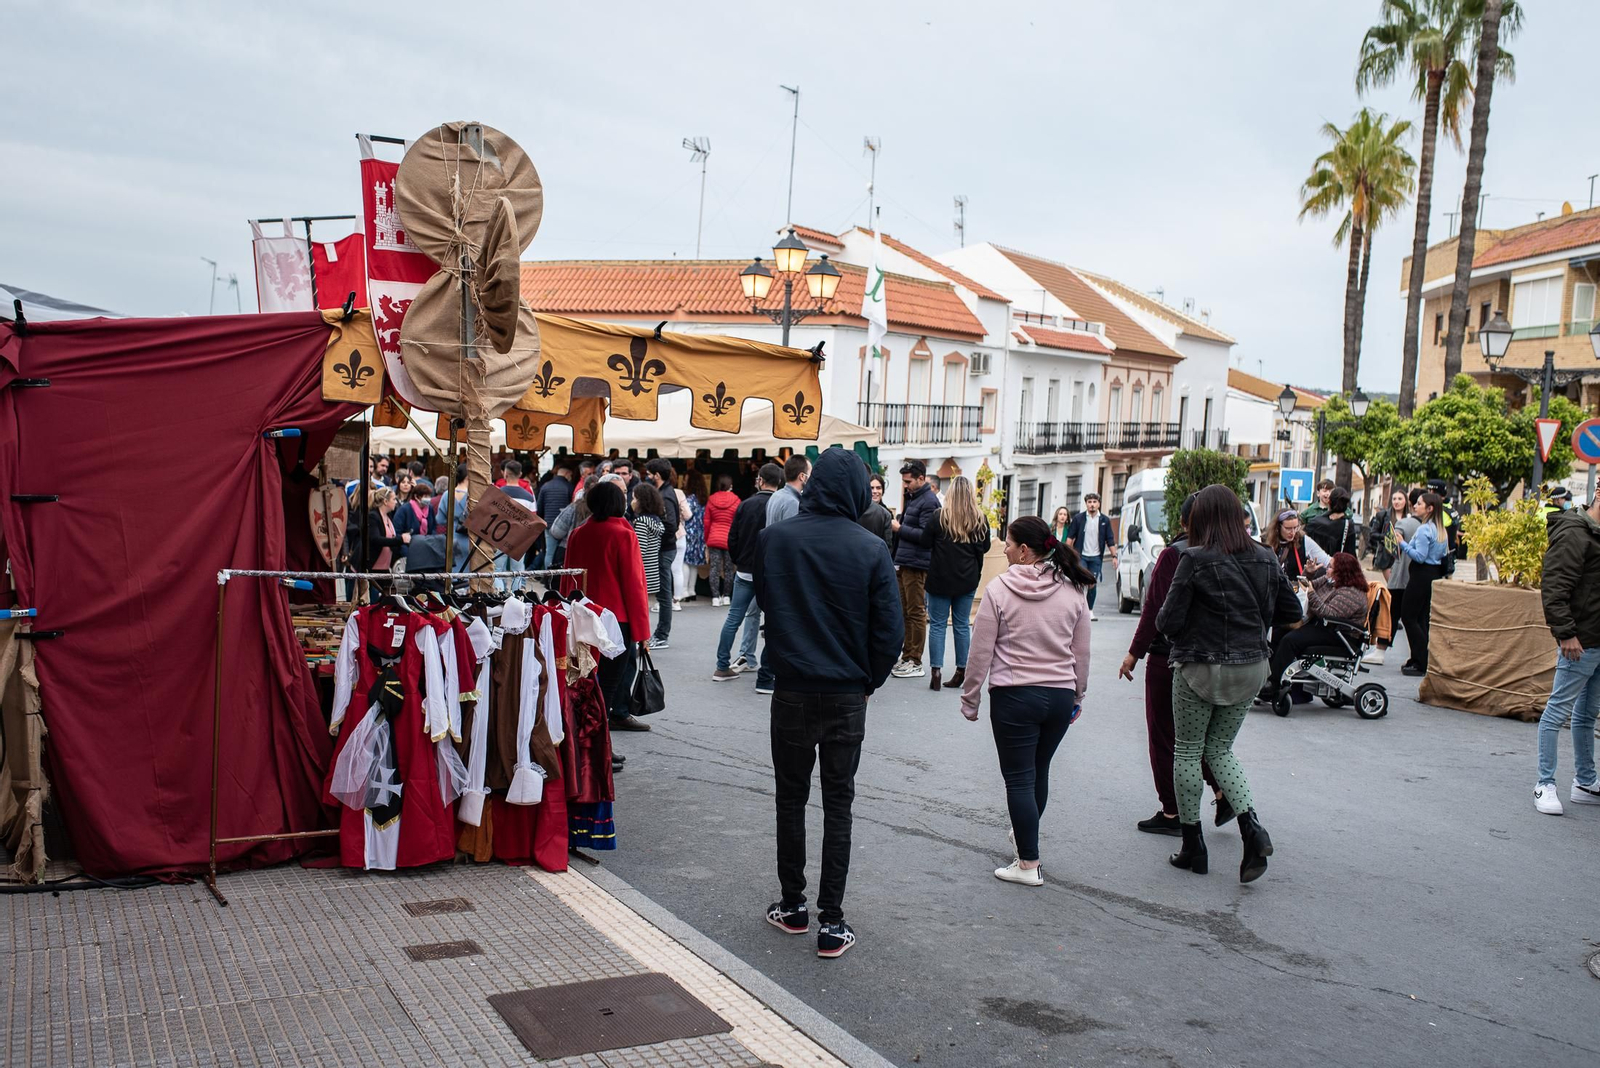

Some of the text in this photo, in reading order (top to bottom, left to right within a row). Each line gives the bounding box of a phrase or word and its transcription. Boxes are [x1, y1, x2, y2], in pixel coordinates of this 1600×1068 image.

[491, 500, 532, 529] MEDIEVALES
[504, 500, 528, 519] TRAJES
[480, 513, 511, 543] 10
